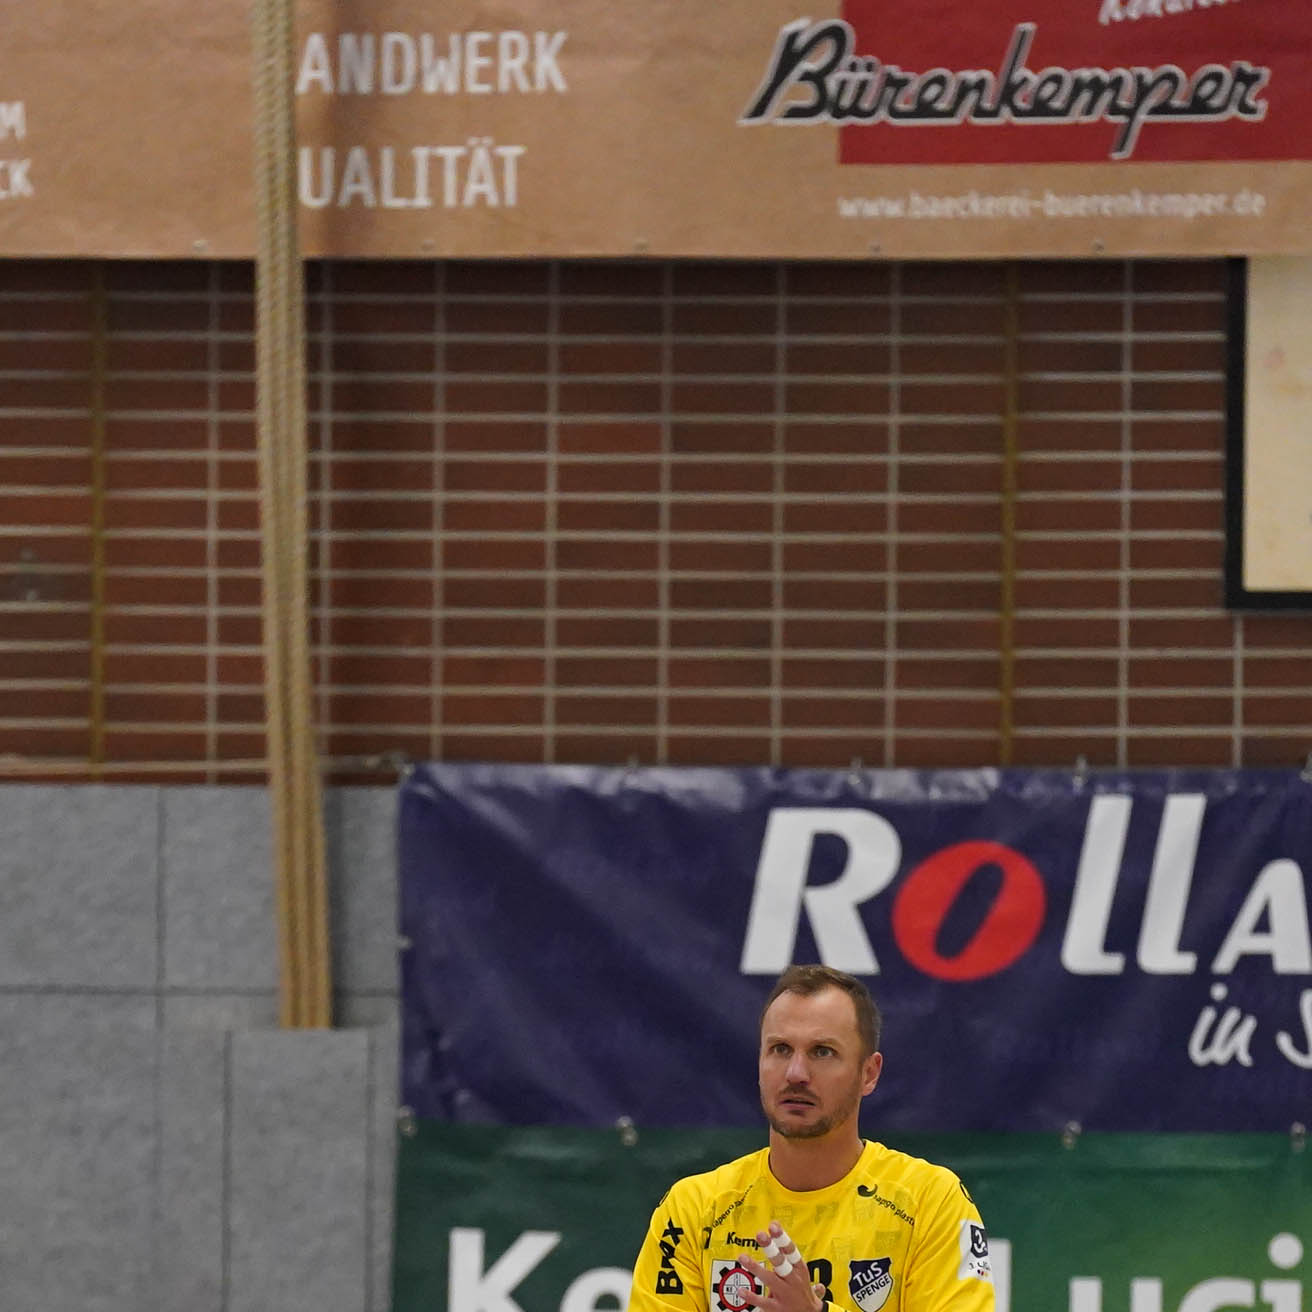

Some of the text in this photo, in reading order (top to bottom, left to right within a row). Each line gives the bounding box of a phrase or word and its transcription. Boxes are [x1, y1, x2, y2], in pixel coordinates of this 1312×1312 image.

[295, 30, 569, 95] ANDWERK
[737, 18, 1271, 160] Bürenkemper
[297, 136, 526, 208] UALITÄT
[1189, 982, 1258, 1067] in
[727, 1231, 762, 1250] Kemp
[852, 1262, 883, 1288] TuS
[855, 1274, 891, 1303] SPENGE
